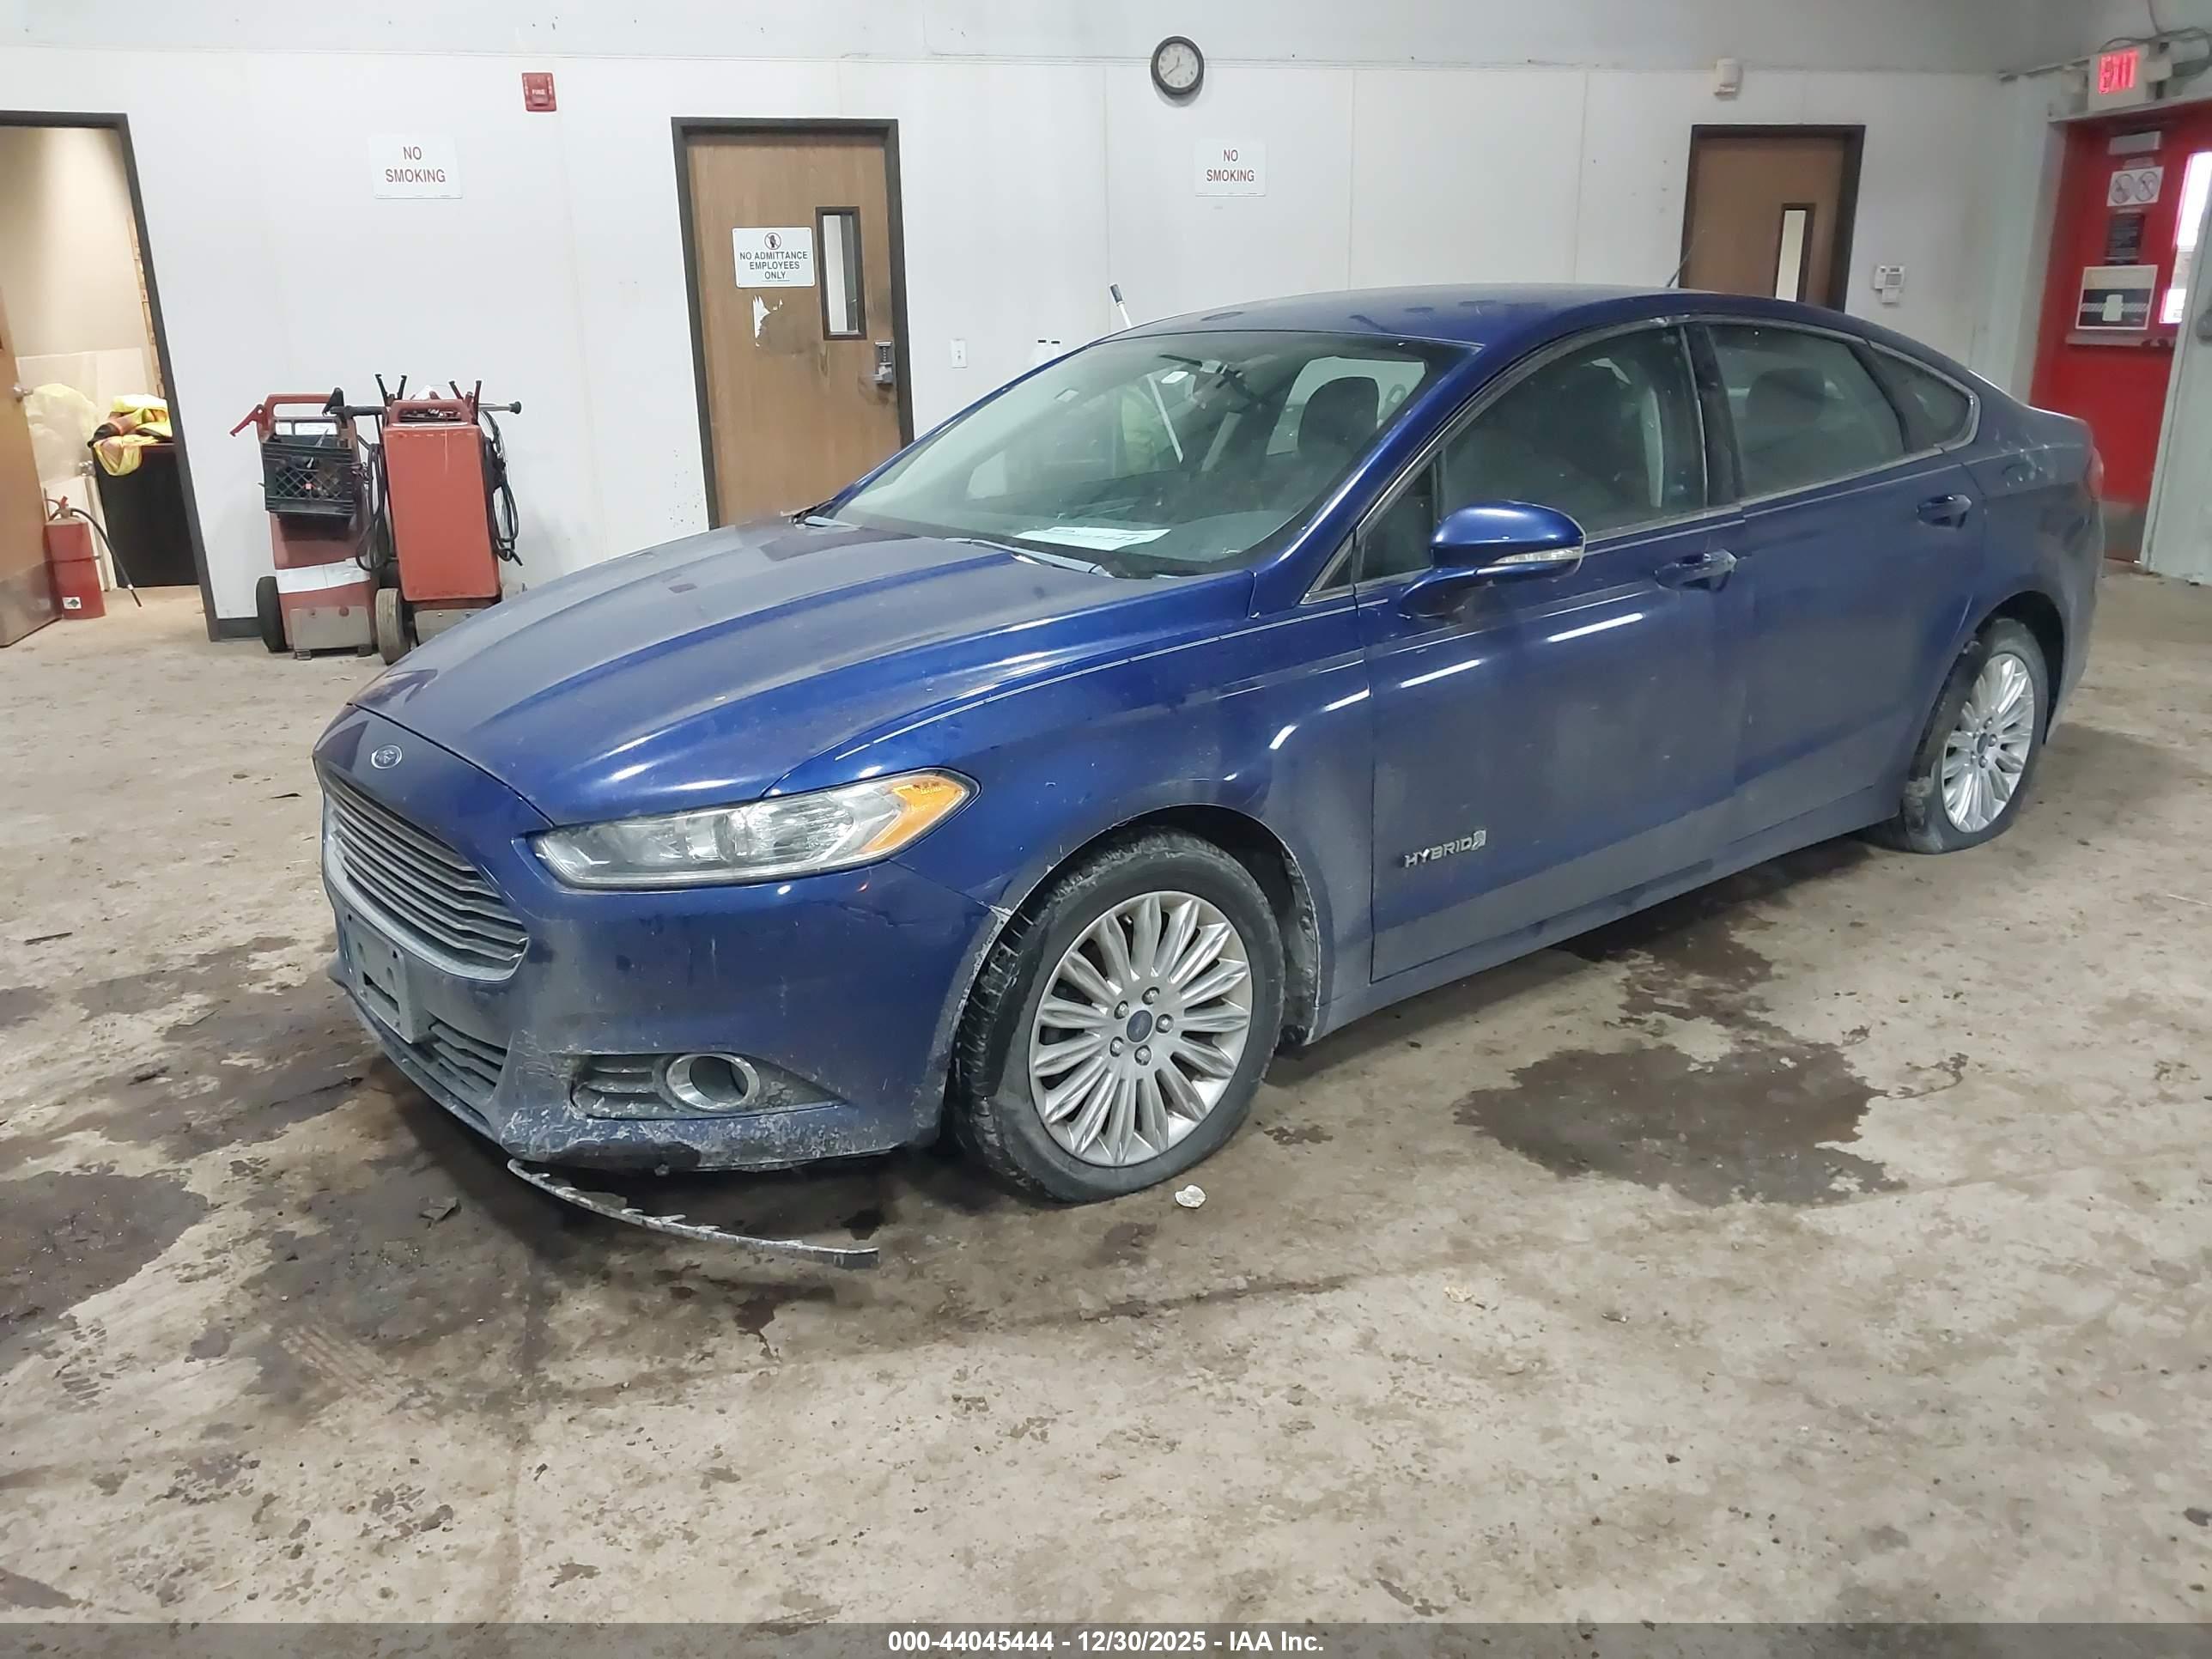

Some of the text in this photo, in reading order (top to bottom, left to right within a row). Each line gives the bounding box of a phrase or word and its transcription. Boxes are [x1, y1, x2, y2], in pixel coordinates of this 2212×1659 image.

[2099, 52, 2136, 94] EXIT
[403, 146, 422, 161] NO
[1223, 149, 1238, 162] NO
[385, 168, 446, 183] SMOKING
[1206, 169, 1255, 182] SMOKING
[739, 251, 808, 260] NO ADMITTANCE
[749, 261, 800, 270] EMPLOYEES
[764, 271, 787, 280] ONLY
[1404, 836, 1473, 868] HYBRID
